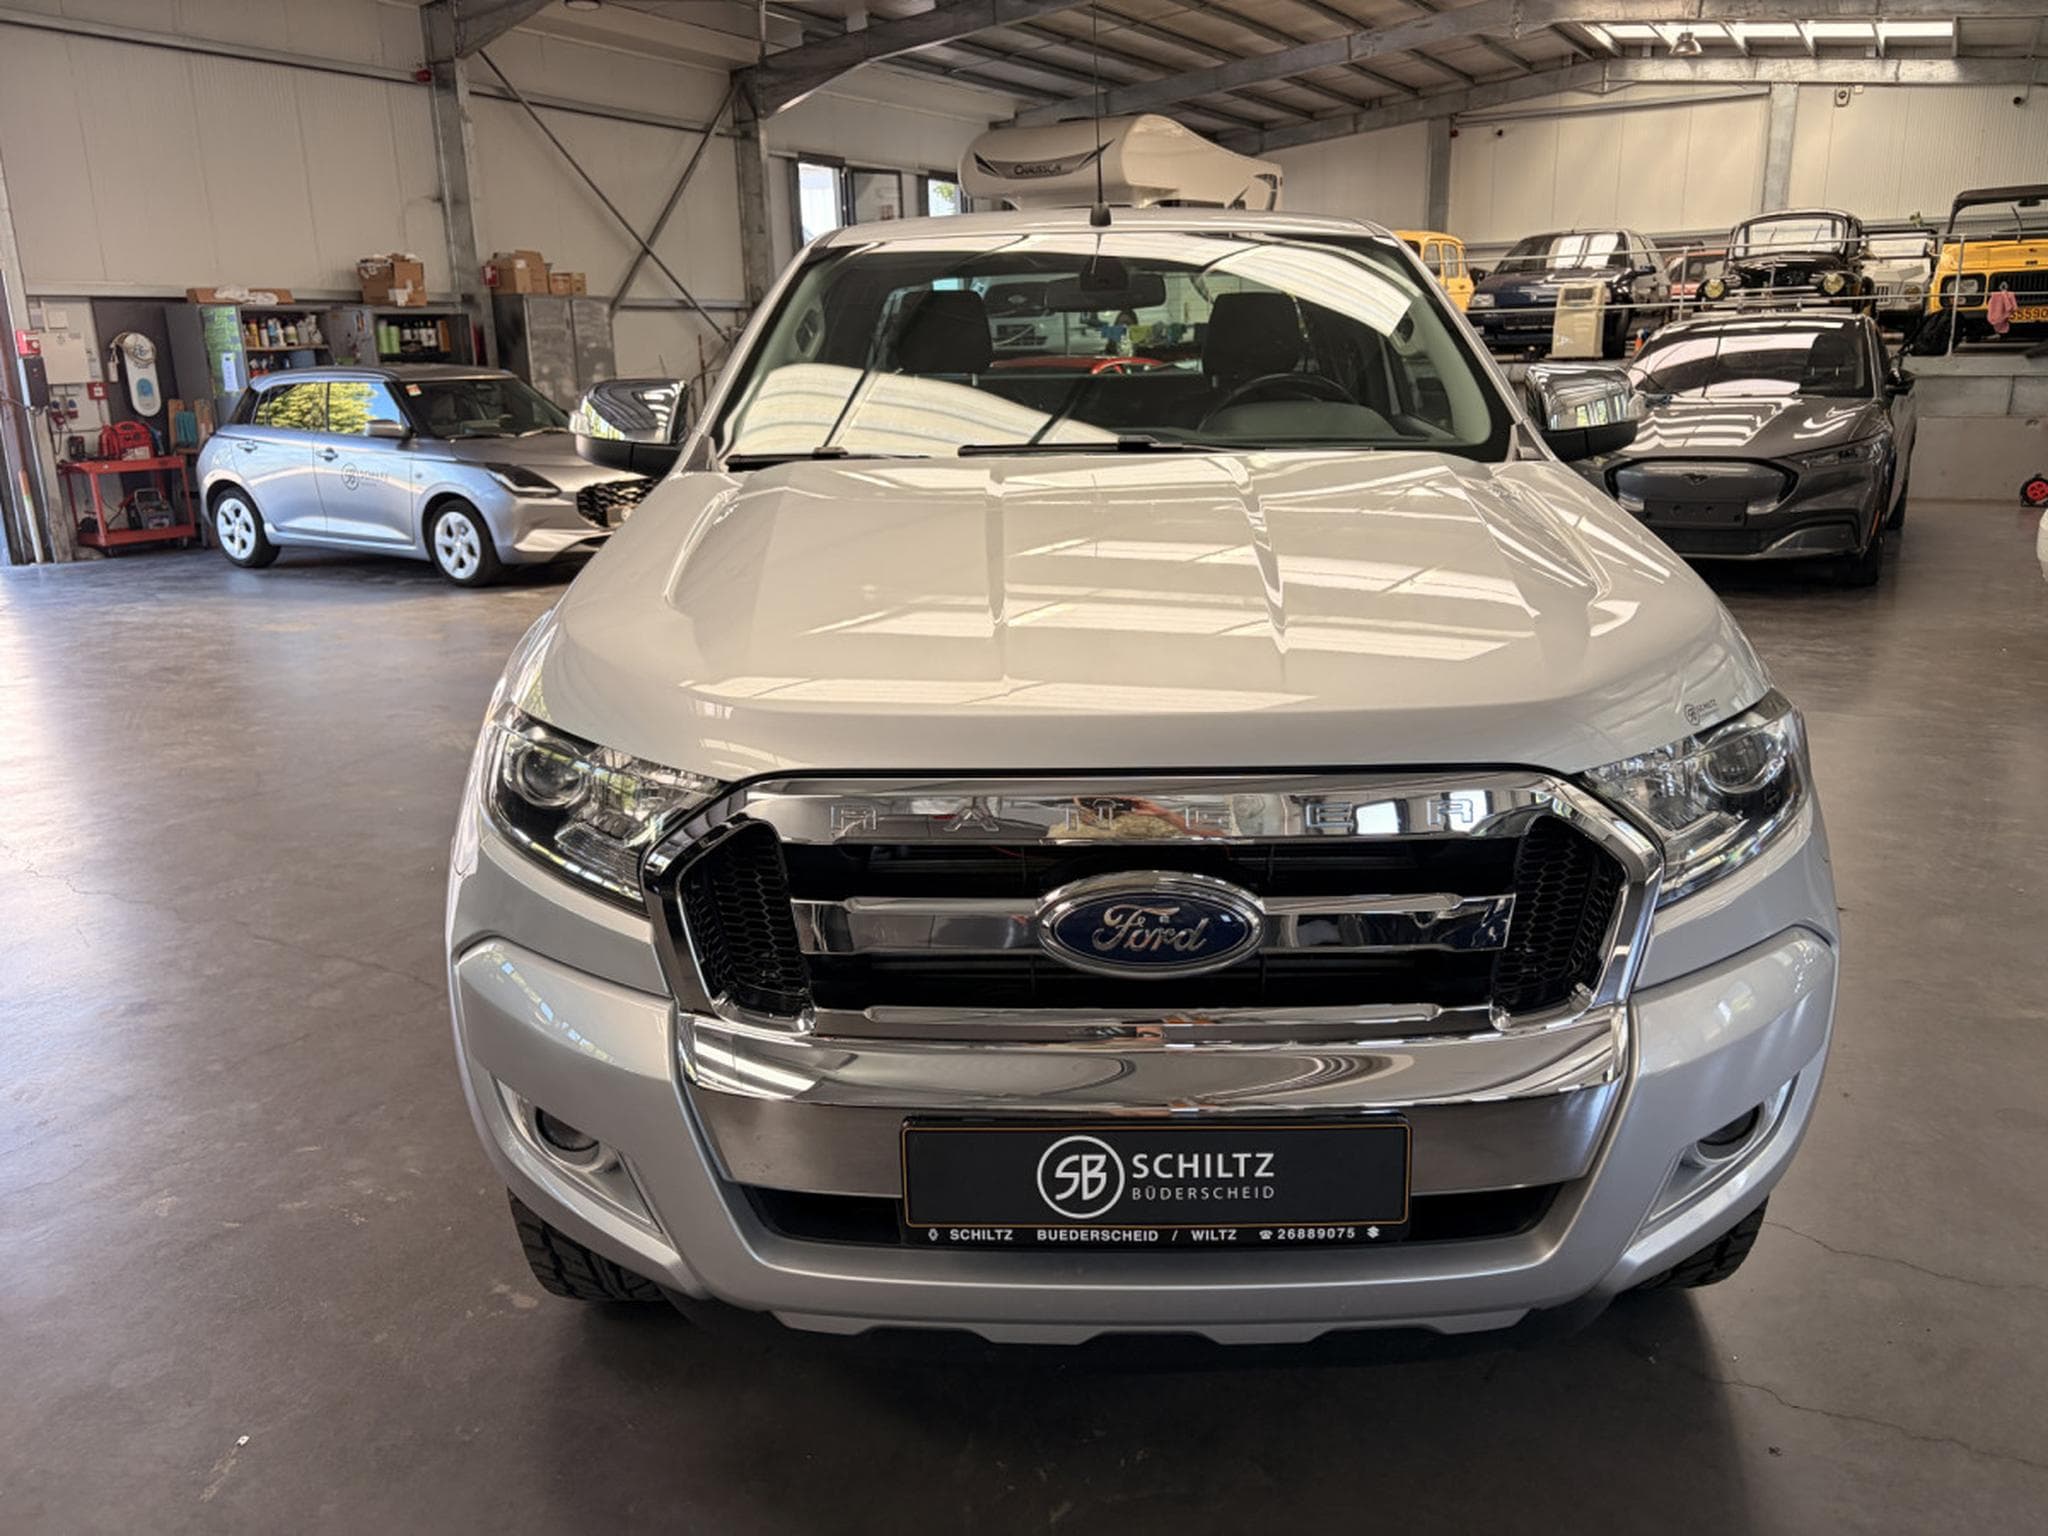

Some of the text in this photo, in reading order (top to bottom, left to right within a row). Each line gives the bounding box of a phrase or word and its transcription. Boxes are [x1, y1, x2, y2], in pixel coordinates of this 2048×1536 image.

[832, 798, 1475, 832] RANGER
[1092, 905, 1208, 952] Ford
[1054, 1154, 1107, 1201] SB
[1132, 1152, 1275, 1179] SCHILTZ
[1131, 1185, 1275, 1200] BÜDERSCHEID
[950, 1229, 1013, 1241] SCHILTZ
[1037, 1229, 1159, 1242] BUEDERSCHEID
[1191, 1229, 1238, 1241] WILTZ
[1277, 1227, 1356, 1240] 26889075
